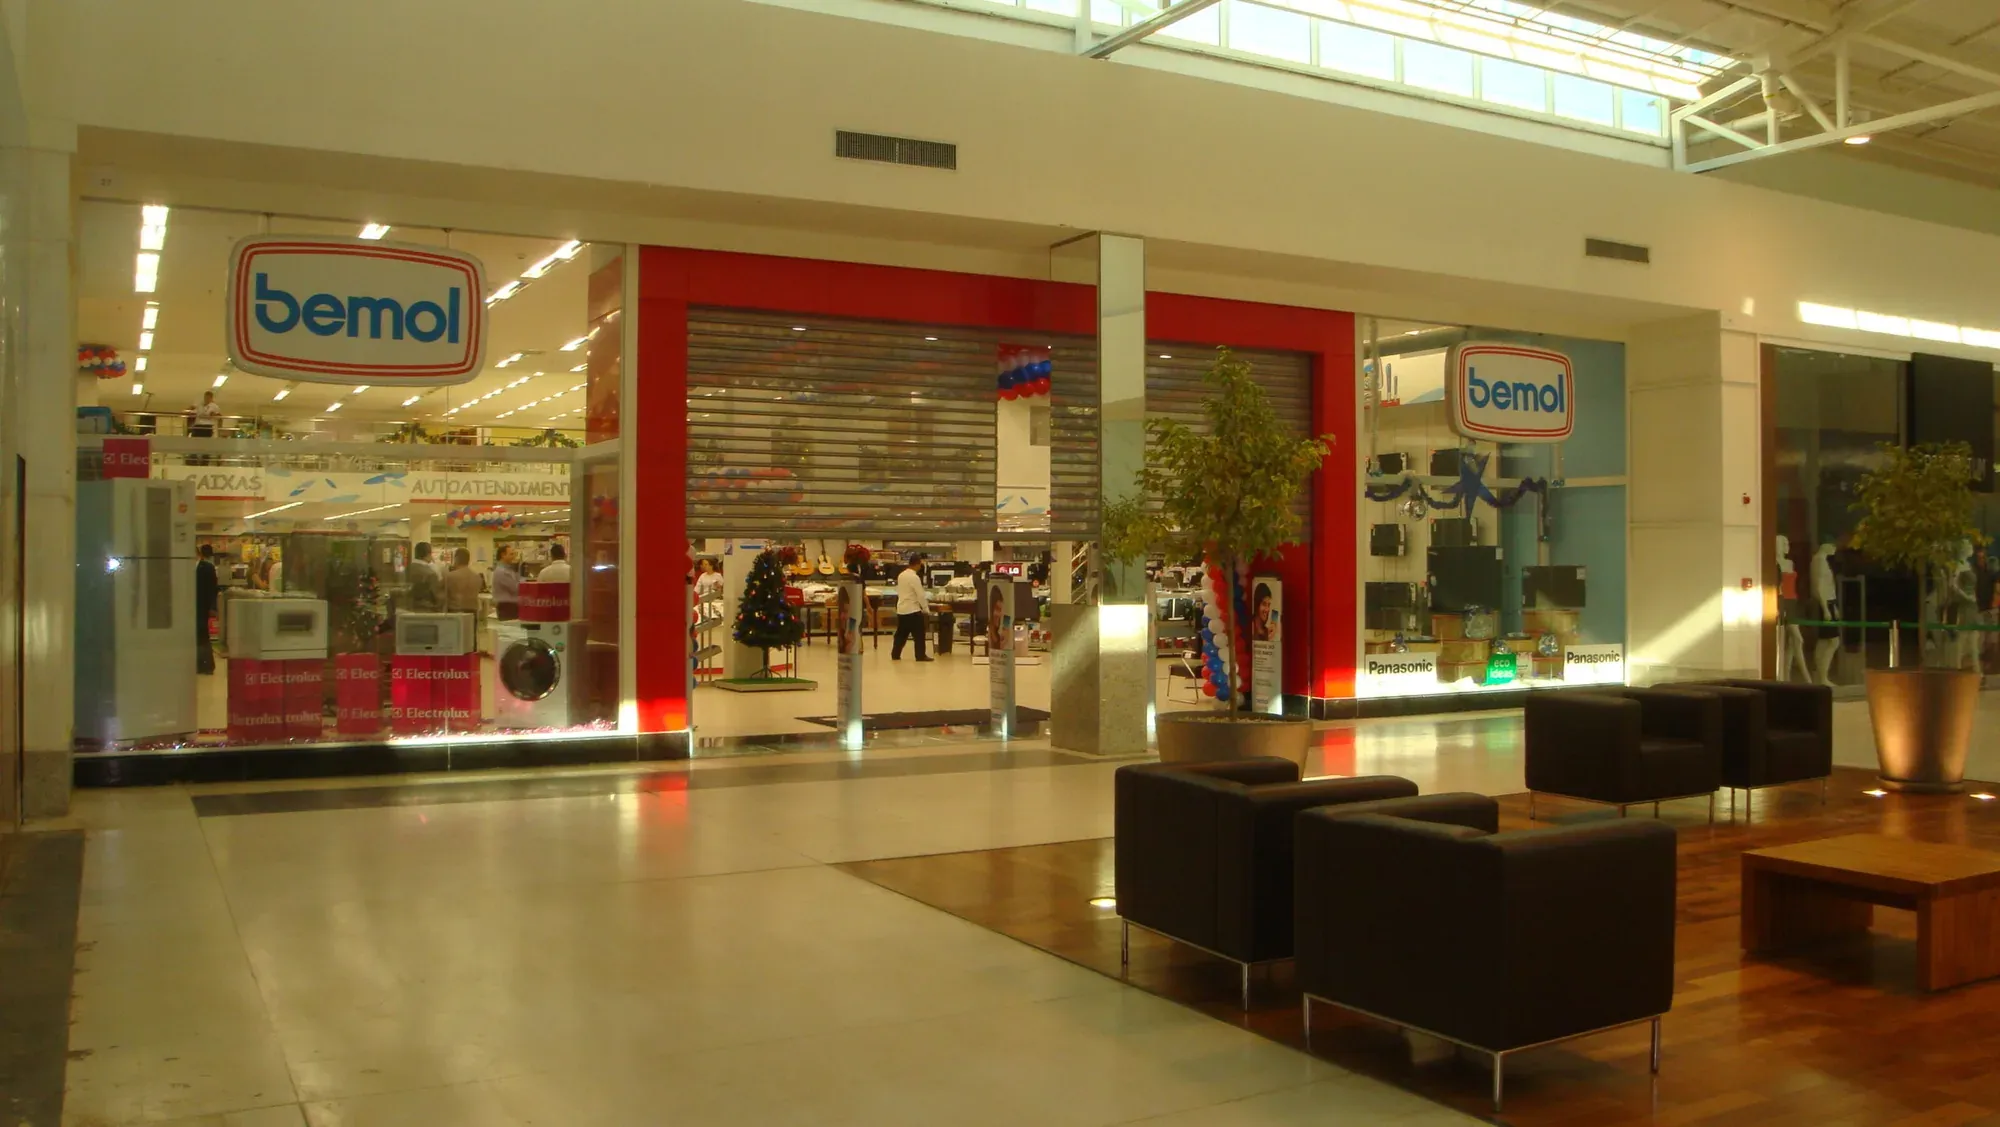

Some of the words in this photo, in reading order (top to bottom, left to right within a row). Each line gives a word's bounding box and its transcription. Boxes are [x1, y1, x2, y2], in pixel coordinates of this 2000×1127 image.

[255, 273, 460, 344] bemol
[1468, 366, 1565, 413] bemol
[1493, 659, 1511, 669] eco
[1565, 650, 1621, 665] Panasonic
[1368, 658, 1433, 676] Panasonic
[1489, 667, 1515, 679] ideas
[260, 671, 322, 685] Electrolux
[405, 668, 470, 681] Electrolux
[406, 707, 470, 720] Electrolux
